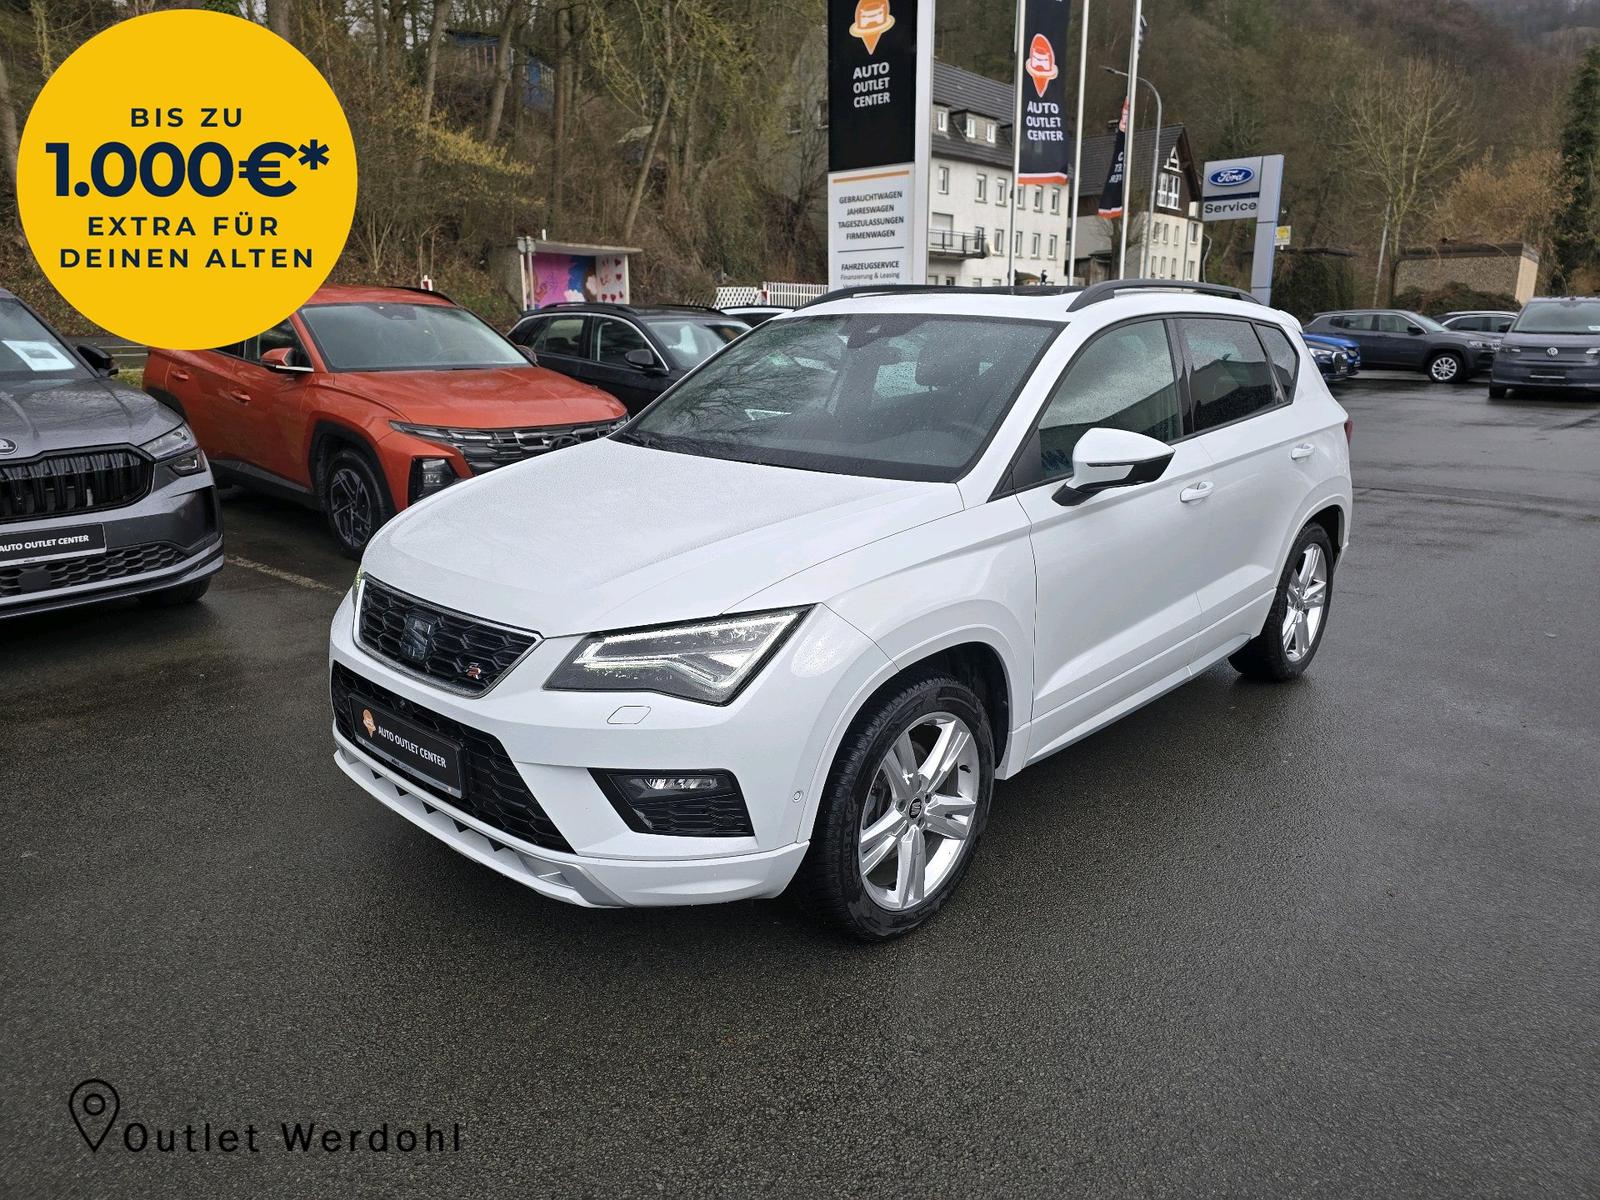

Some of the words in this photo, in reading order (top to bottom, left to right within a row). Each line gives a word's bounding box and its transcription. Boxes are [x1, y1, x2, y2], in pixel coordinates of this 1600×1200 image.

[853, 62, 890, 79] AUTO
[853, 77, 890, 94] OUTLET
[853, 92, 890, 108] CENTER
[1026, 101, 1059, 114] AUTO
[1026, 115, 1061, 128] OUTLET
[1027, 129, 1064, 141] CENTER
[1217, 170, 1245, 182] Ford
[839, 190, 903, 204] GEBRAUCHTWAGEN
[847, 204, 895, 216] JAHRESWAGEN
[1204, 201, 1257, 214] Service
[838, 216, 904, 228] TAGESZULASSUNGEN
[846, 230, 895, 240] FIRMENWAGEN
[841, 260, 899, 271] FAHRZEUGSERVICE
[24, 538, 57, 549] OUTLET
[58, 534, 89, 545] CENTER
[378, 725, 394, 742] AUTO
[394, 734, 419, 755] OUTLET
[419, 748, 447, 768] CENTER
